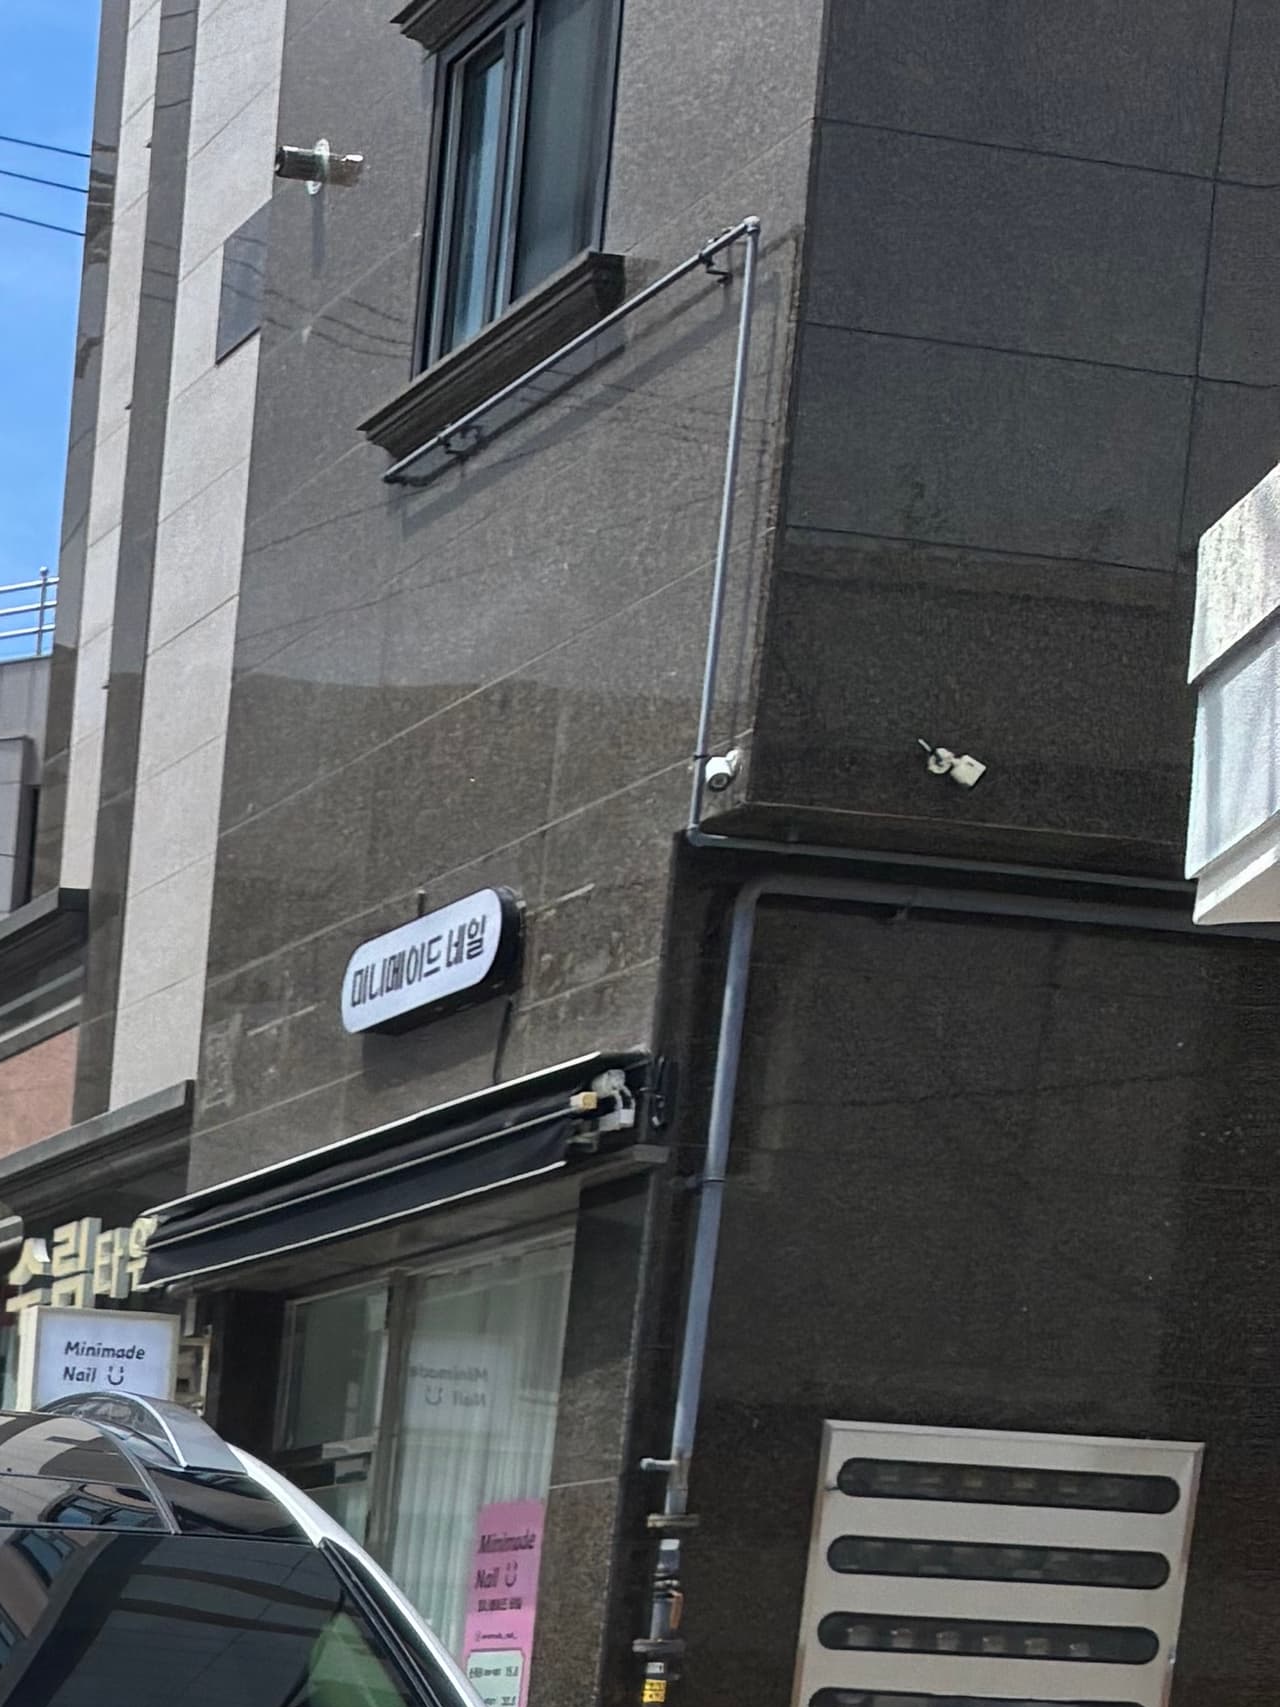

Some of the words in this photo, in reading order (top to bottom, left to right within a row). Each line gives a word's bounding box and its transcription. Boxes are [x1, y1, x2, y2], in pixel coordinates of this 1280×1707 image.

[64, 1340, 146, 1361] Minimade
[62, 1366, 97, 1384] Nail
[477, 1530, 537, 1554] Minimade
[475, 1567, 500, 1589] Nail
